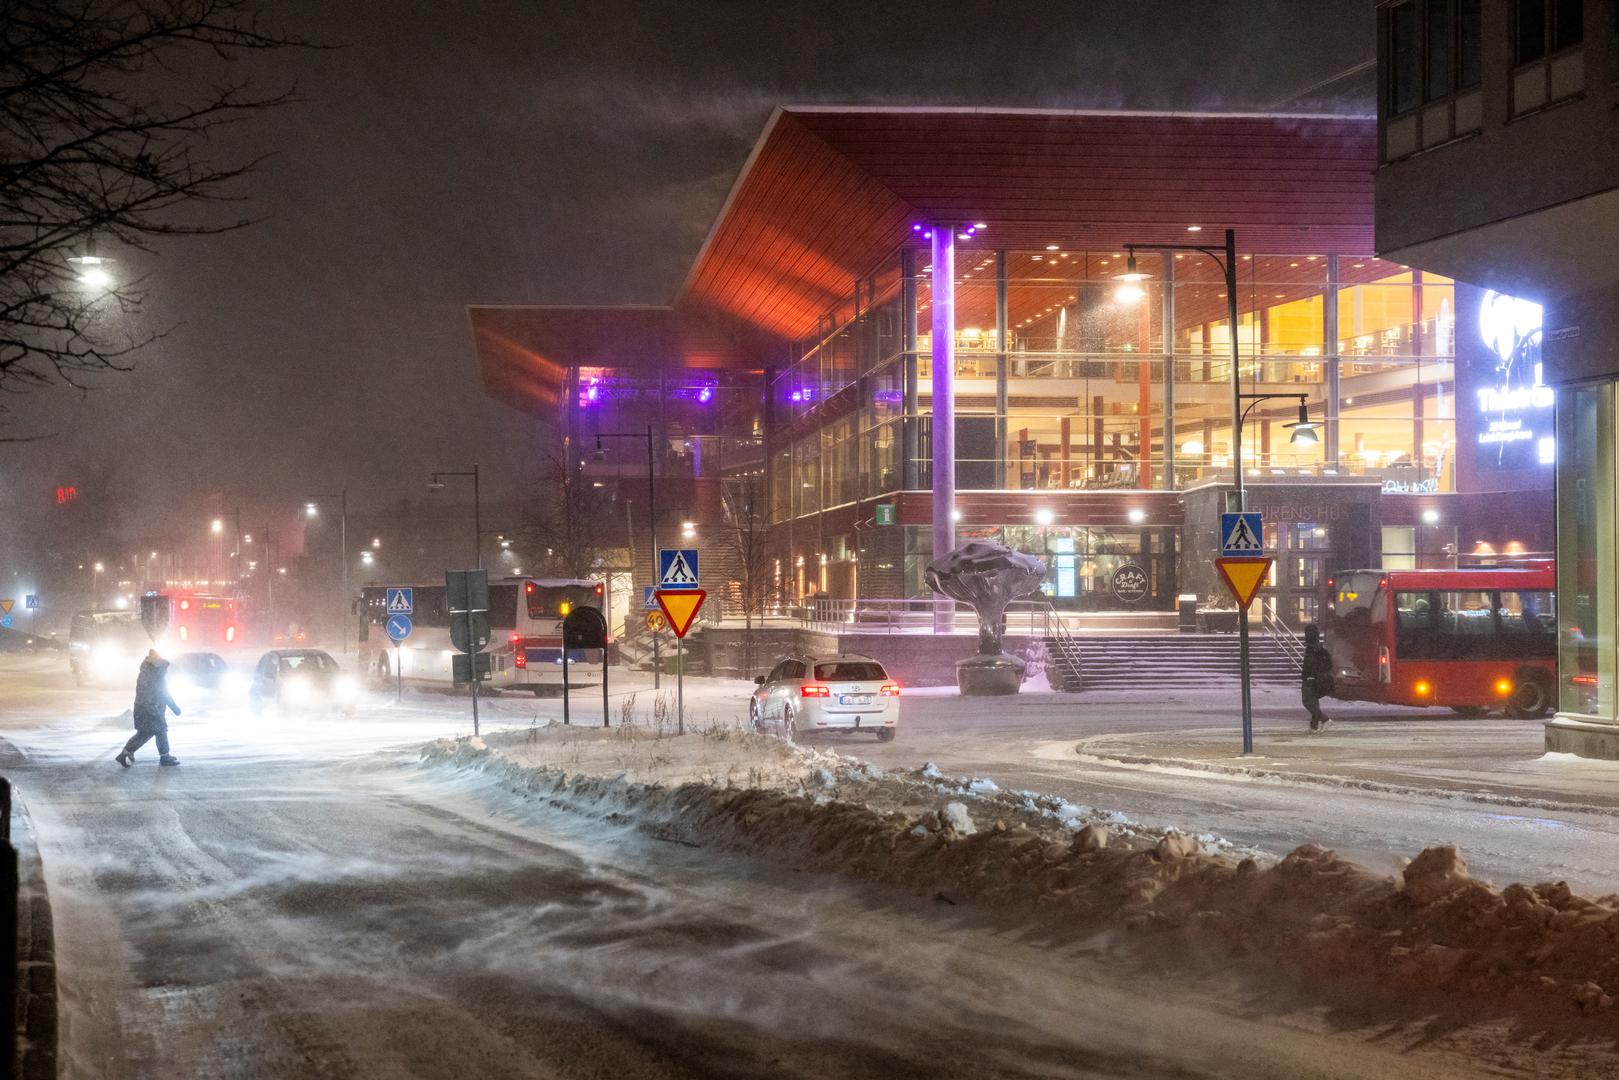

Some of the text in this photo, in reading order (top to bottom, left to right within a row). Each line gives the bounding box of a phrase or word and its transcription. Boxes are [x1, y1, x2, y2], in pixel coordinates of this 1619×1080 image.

[1115, 571, 1146, 585] CRAFT
[1120, 581, 1139, 590] Draft
[648, 614, 663, 626] 40
